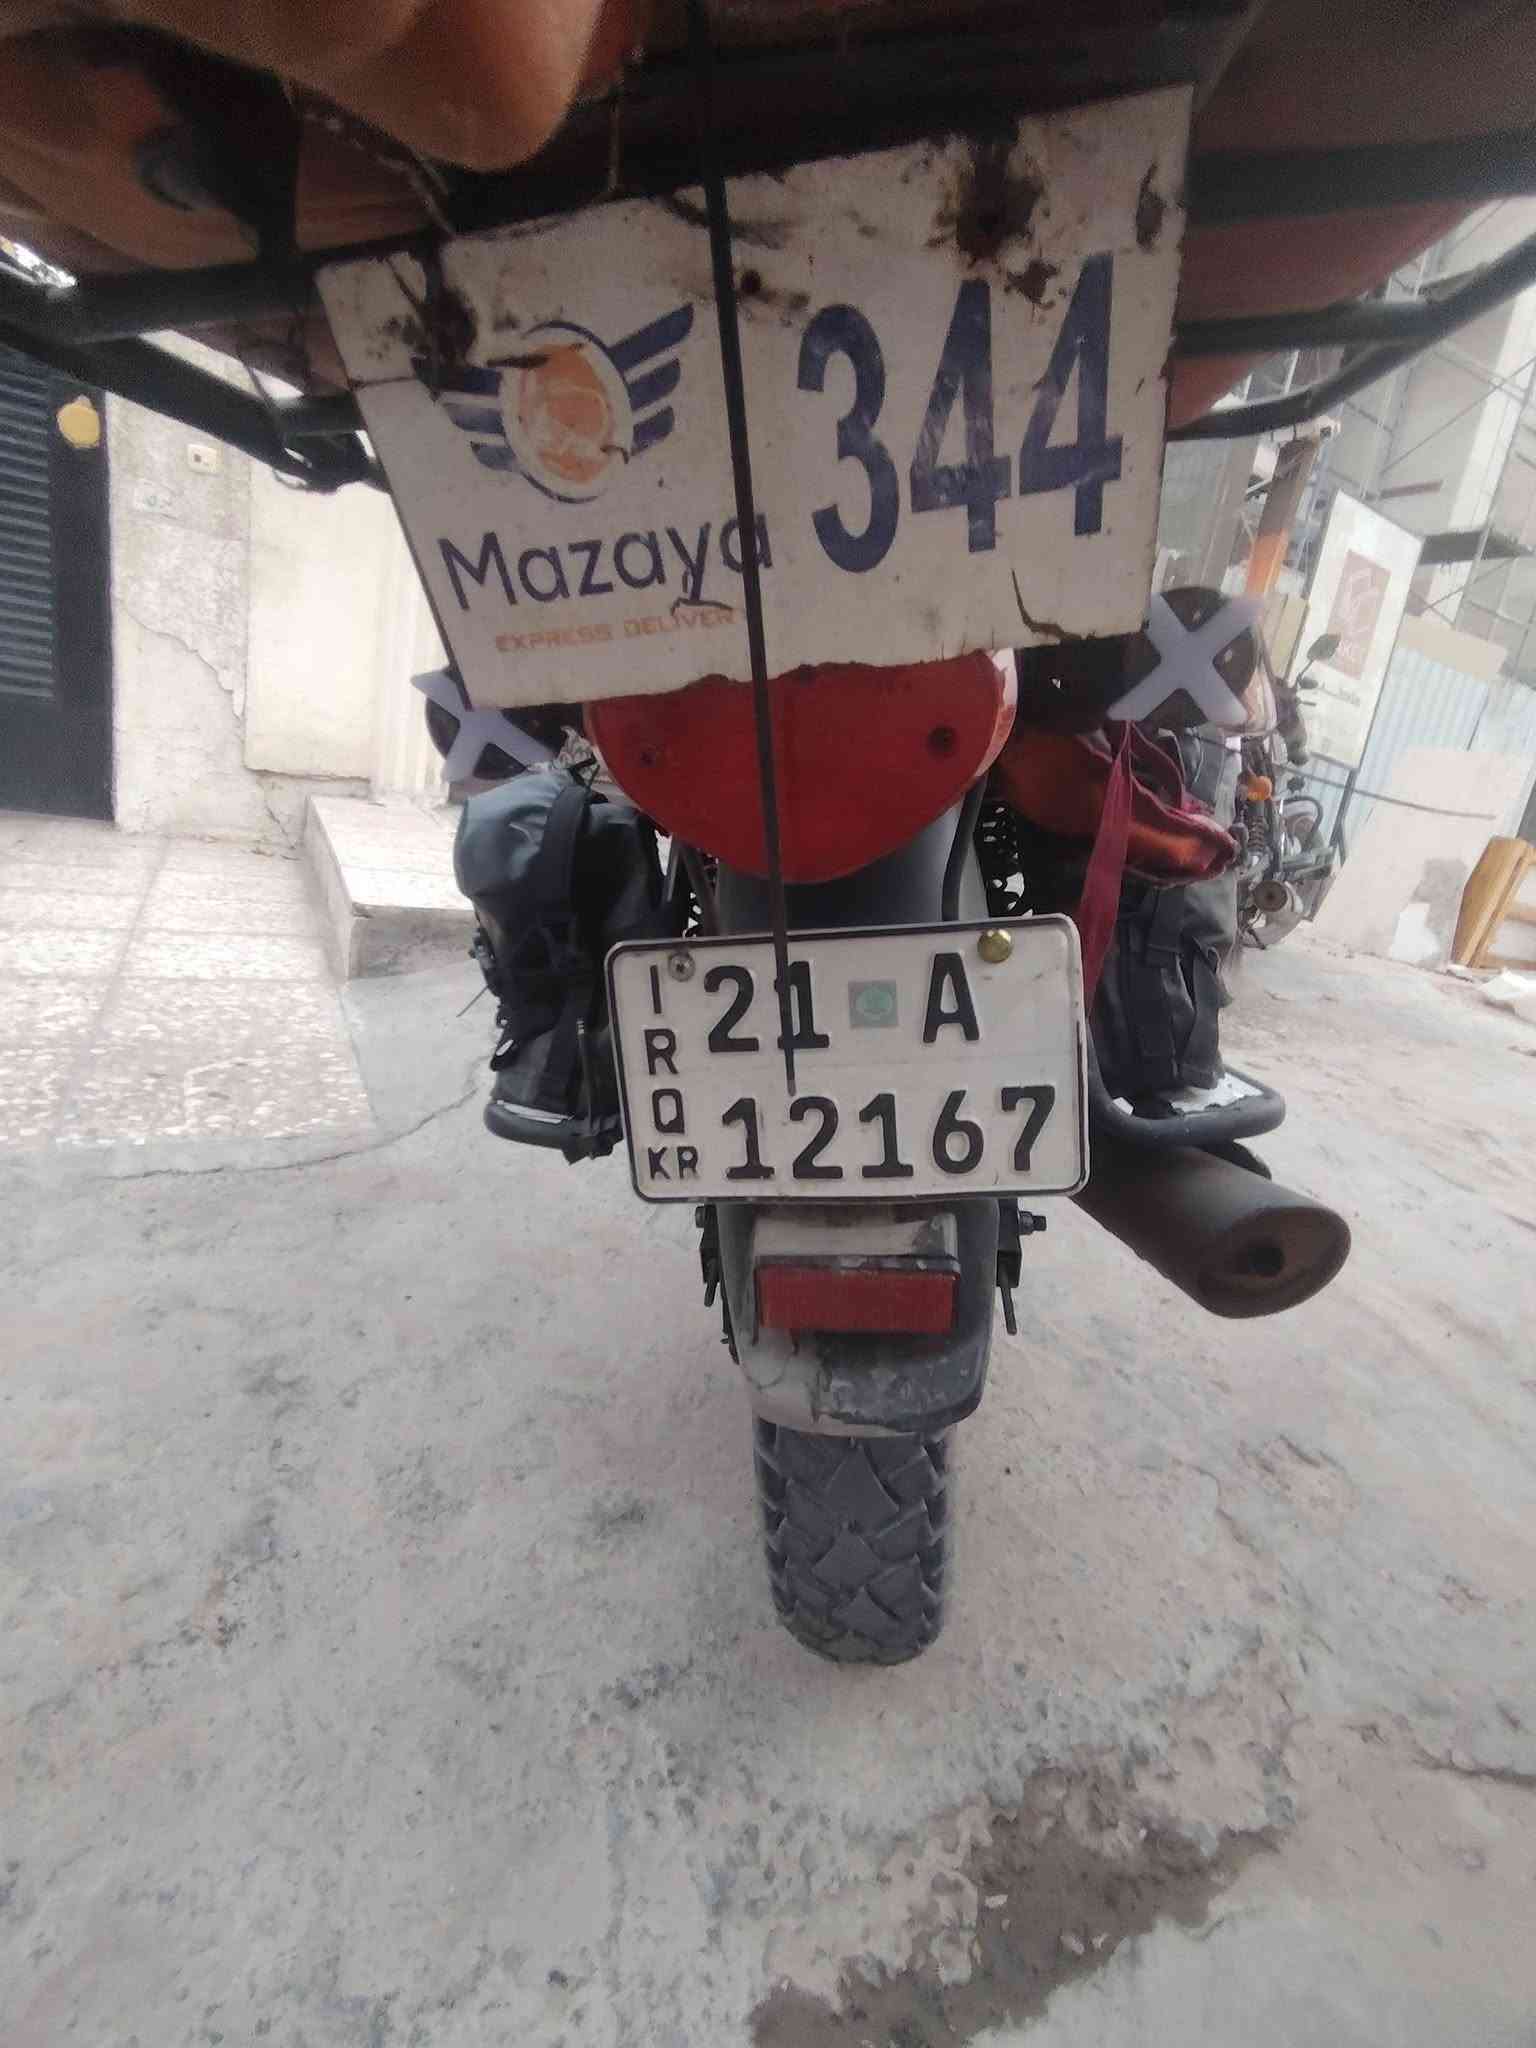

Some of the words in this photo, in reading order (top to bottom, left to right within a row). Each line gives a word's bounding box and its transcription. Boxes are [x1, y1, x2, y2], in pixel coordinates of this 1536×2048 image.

[797, 252, 1124, 573] 344
[437, 512, 773, 611] Mazaya
[495, 623, 613, 653] EXPRESS
[623, 604, 754, 638] DELIVER
[704, 960, 830, 1053] 21
[922, 952, 980, 1044] A
[648, 1145, 699, 1181] KR
[721, 1084, 1056, 1180] 12167
